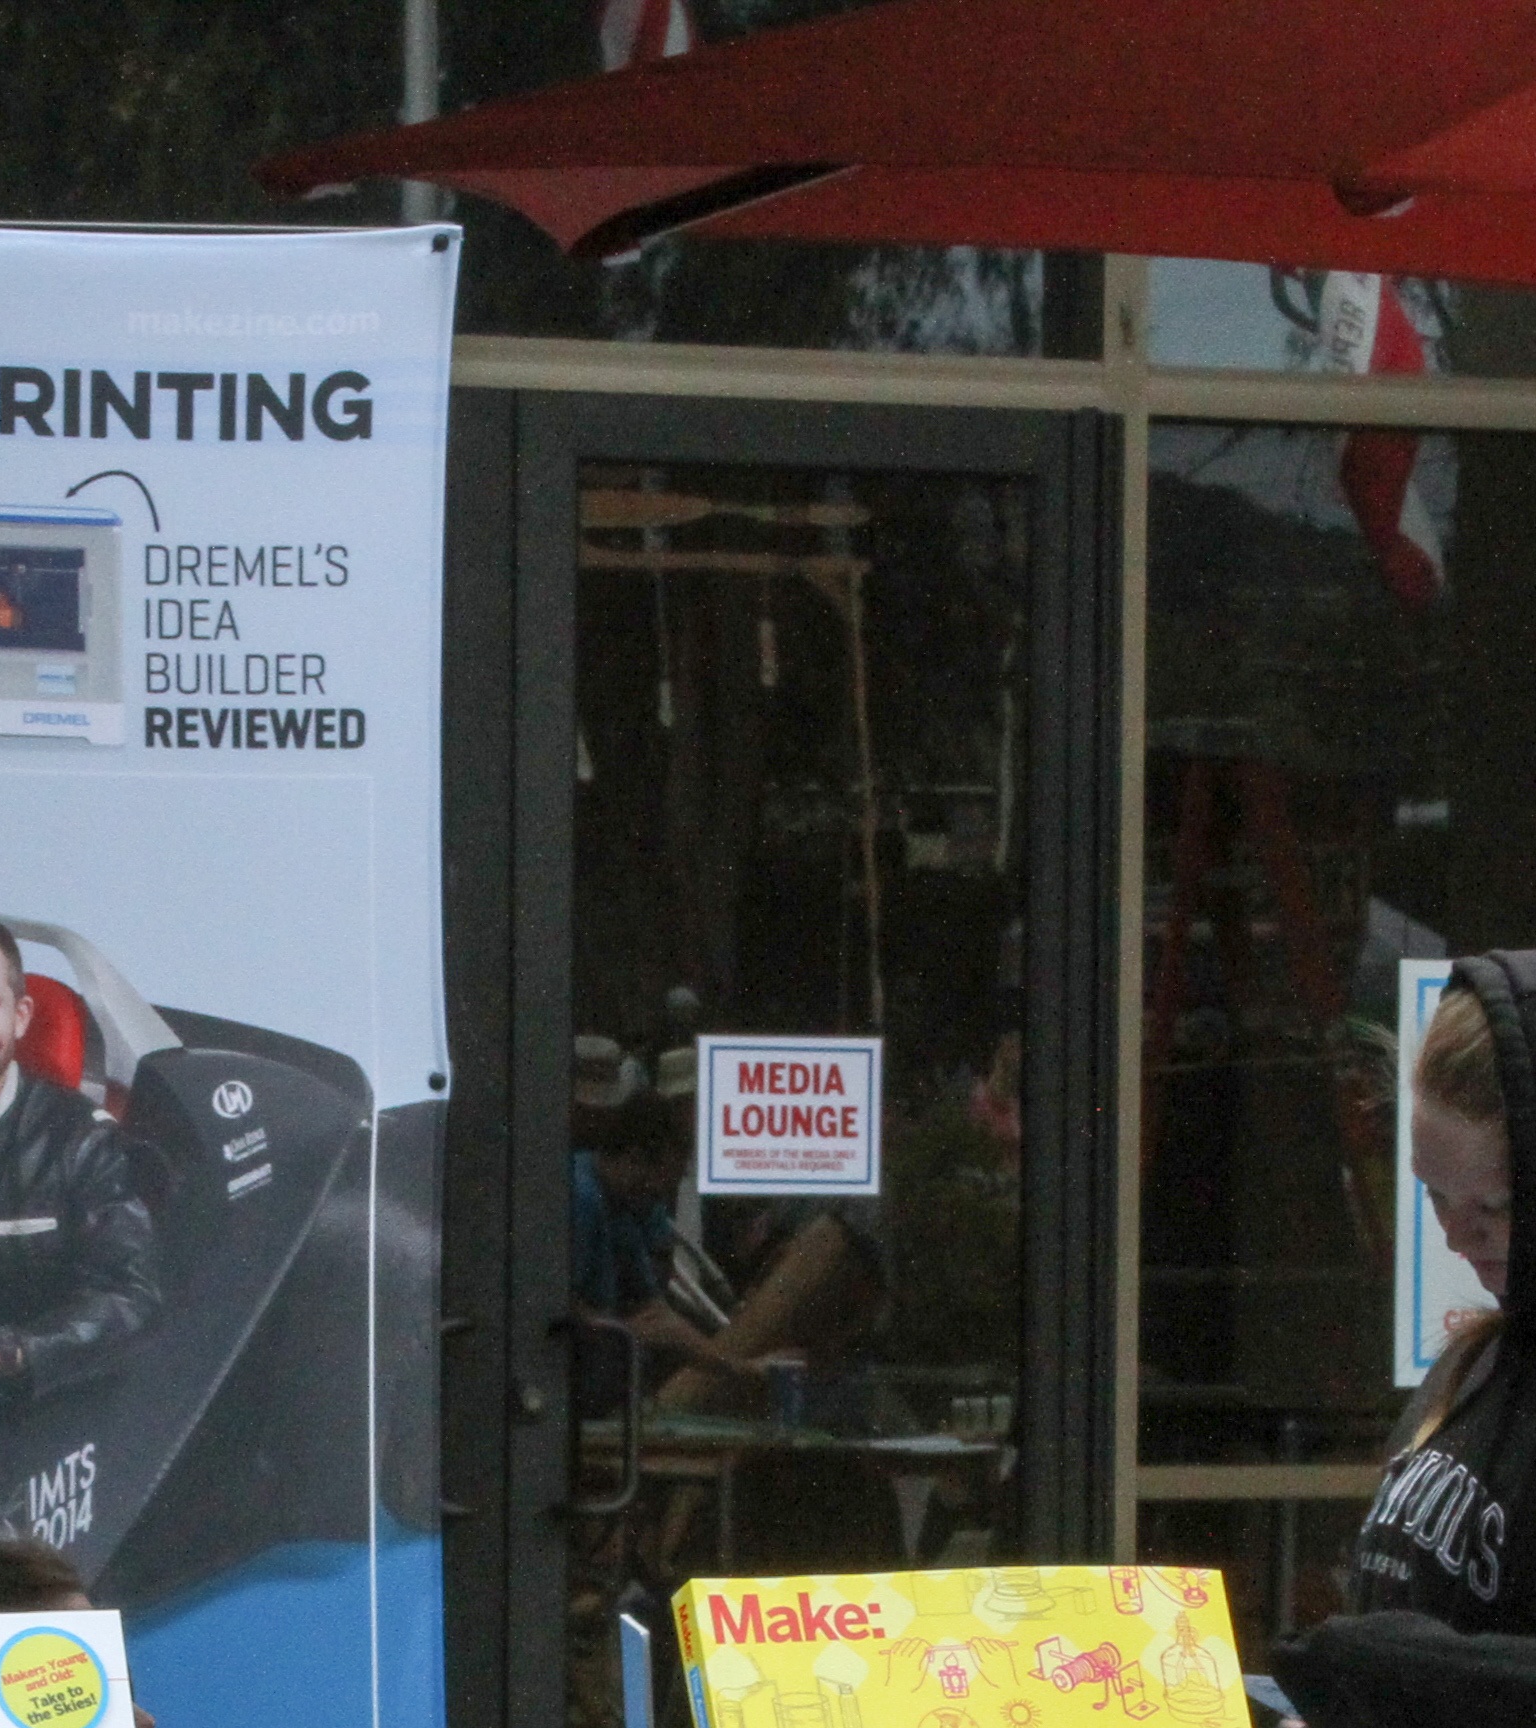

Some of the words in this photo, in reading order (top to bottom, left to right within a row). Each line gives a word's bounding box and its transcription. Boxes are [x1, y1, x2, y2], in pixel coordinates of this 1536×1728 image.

[145, 544, 349, 587] DREMEL'S
[145, 600, 240, 640] IDEA
[145, 653, 326, 696] BUILDER
[23, 711, 90, 727] DREMEL
[145, 707, 366, 750] REVIEWED
[738, 1061, 846, 1096] MEDIA
[722, 1104, 860, 1139] LOUNGE
[29, 1443, 96, 1521] IMTS
[708, 1591, 886, 1646] Make:
[1, 1665, 47, 1686] Makers
[47, 1652, 88, 1671] Young
[26, 1678, 48, 1692] and
[27, 1710, 52, 1725] the
[53, 1692, 98, 1717] Skies!
[29, 1691, 66, 1709] Take
[67, 1686, 84, 1698] to
